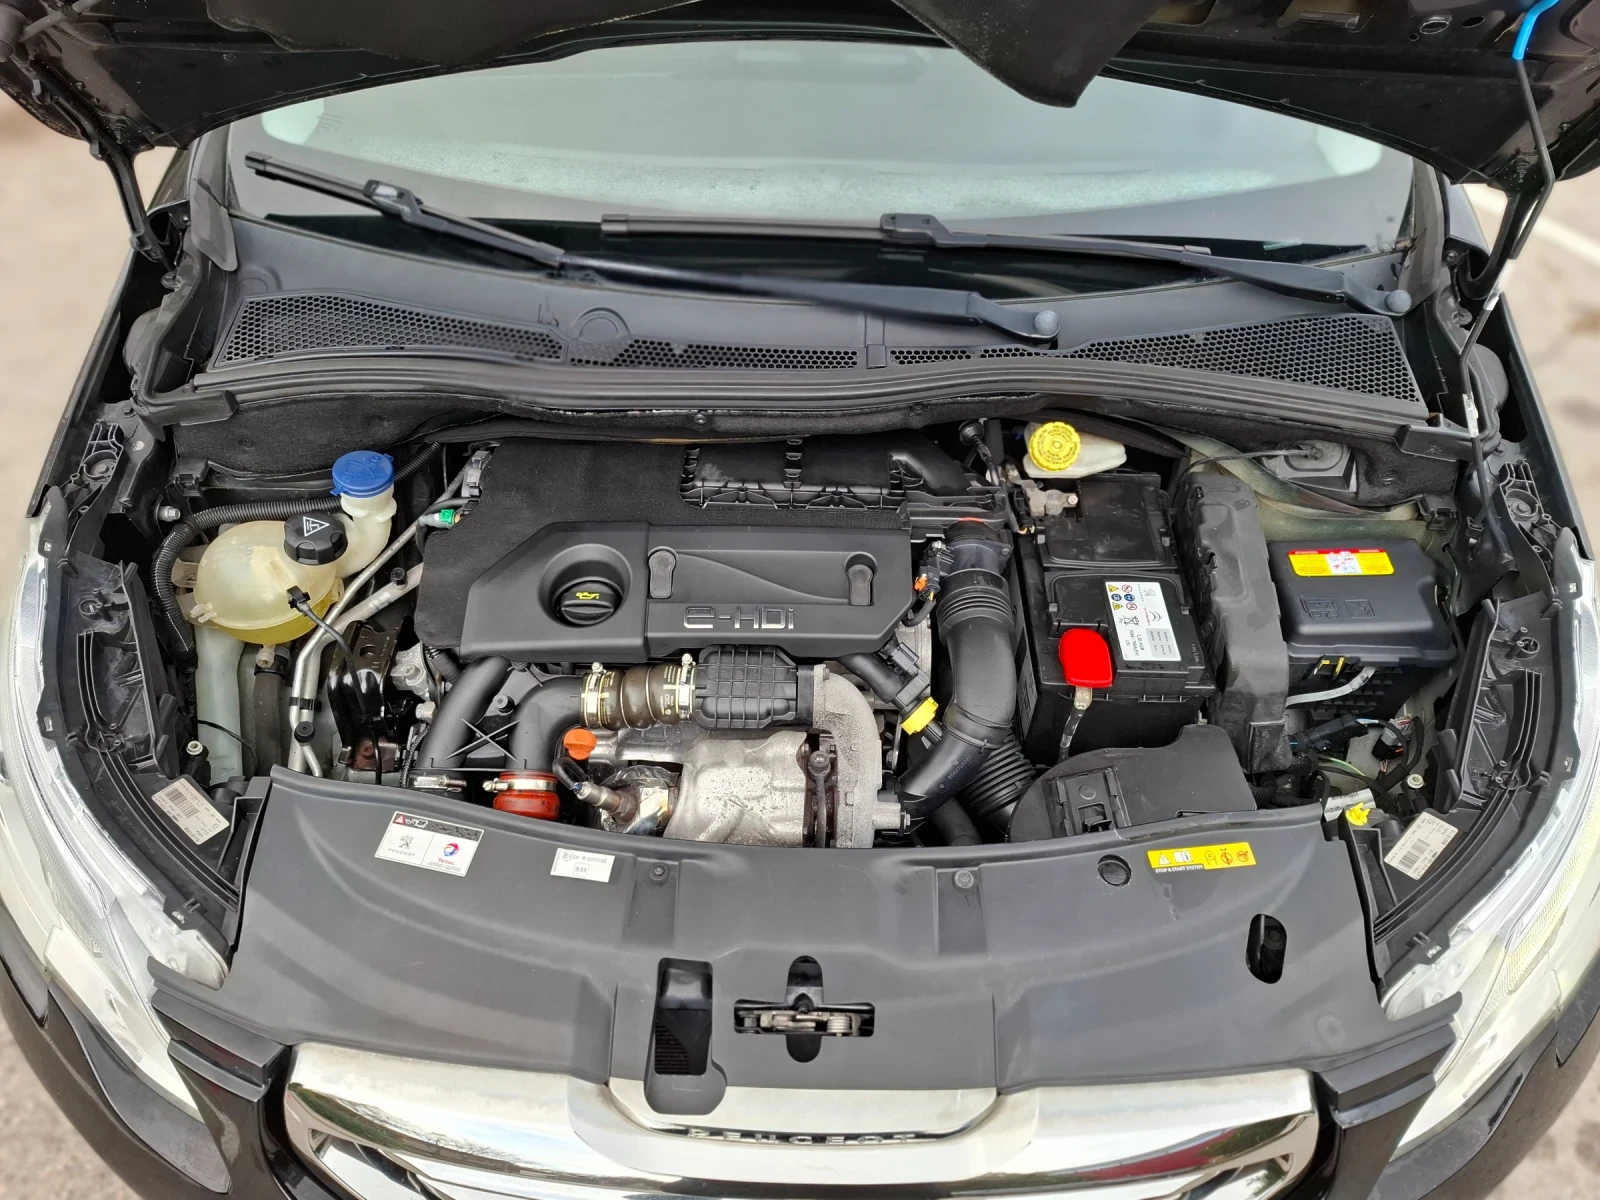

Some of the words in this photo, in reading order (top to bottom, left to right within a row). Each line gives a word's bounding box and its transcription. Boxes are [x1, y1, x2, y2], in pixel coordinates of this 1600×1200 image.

[683, 605, 794, 629] e-HDi
[387, 848, 416, 857] PEUGEOT
[688, 1127, 915, 1144] PEUGEOT
